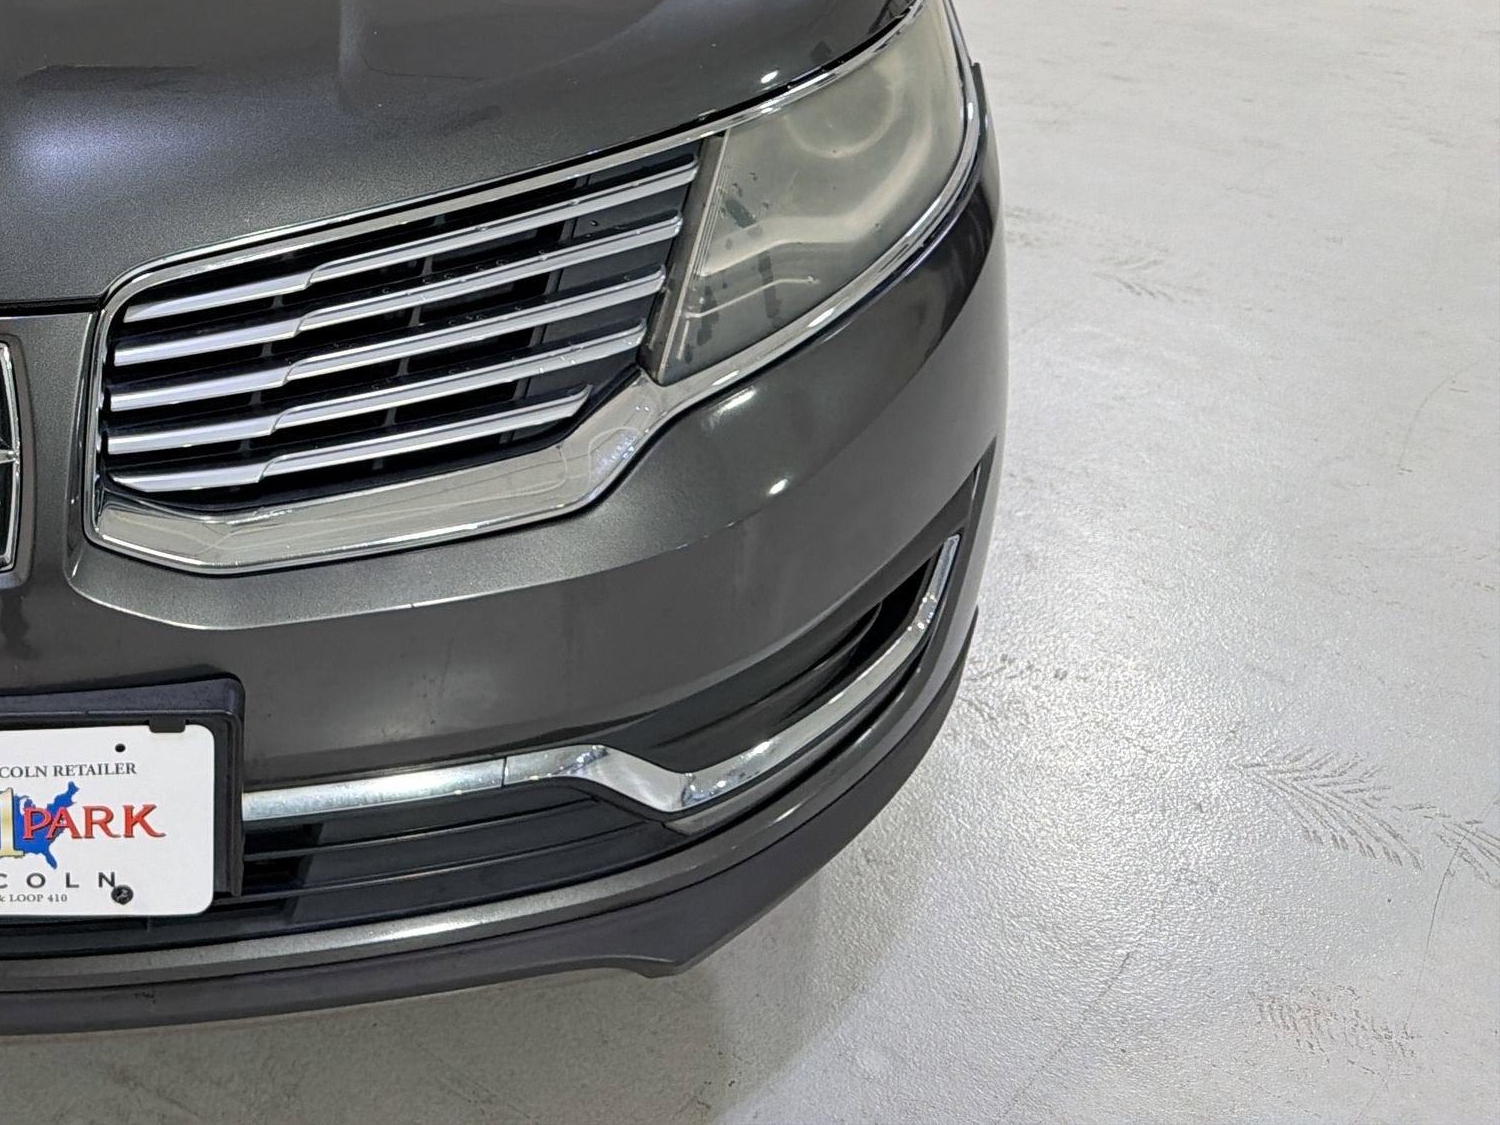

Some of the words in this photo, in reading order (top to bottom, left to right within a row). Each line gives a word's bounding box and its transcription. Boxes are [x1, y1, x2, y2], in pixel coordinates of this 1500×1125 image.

[53, 762, 137, 777] RETAILER
[22, 803, 166, 840] PARK
[9, 893, 45, 904] LOOP
[48, 893, 68, 903] 410
